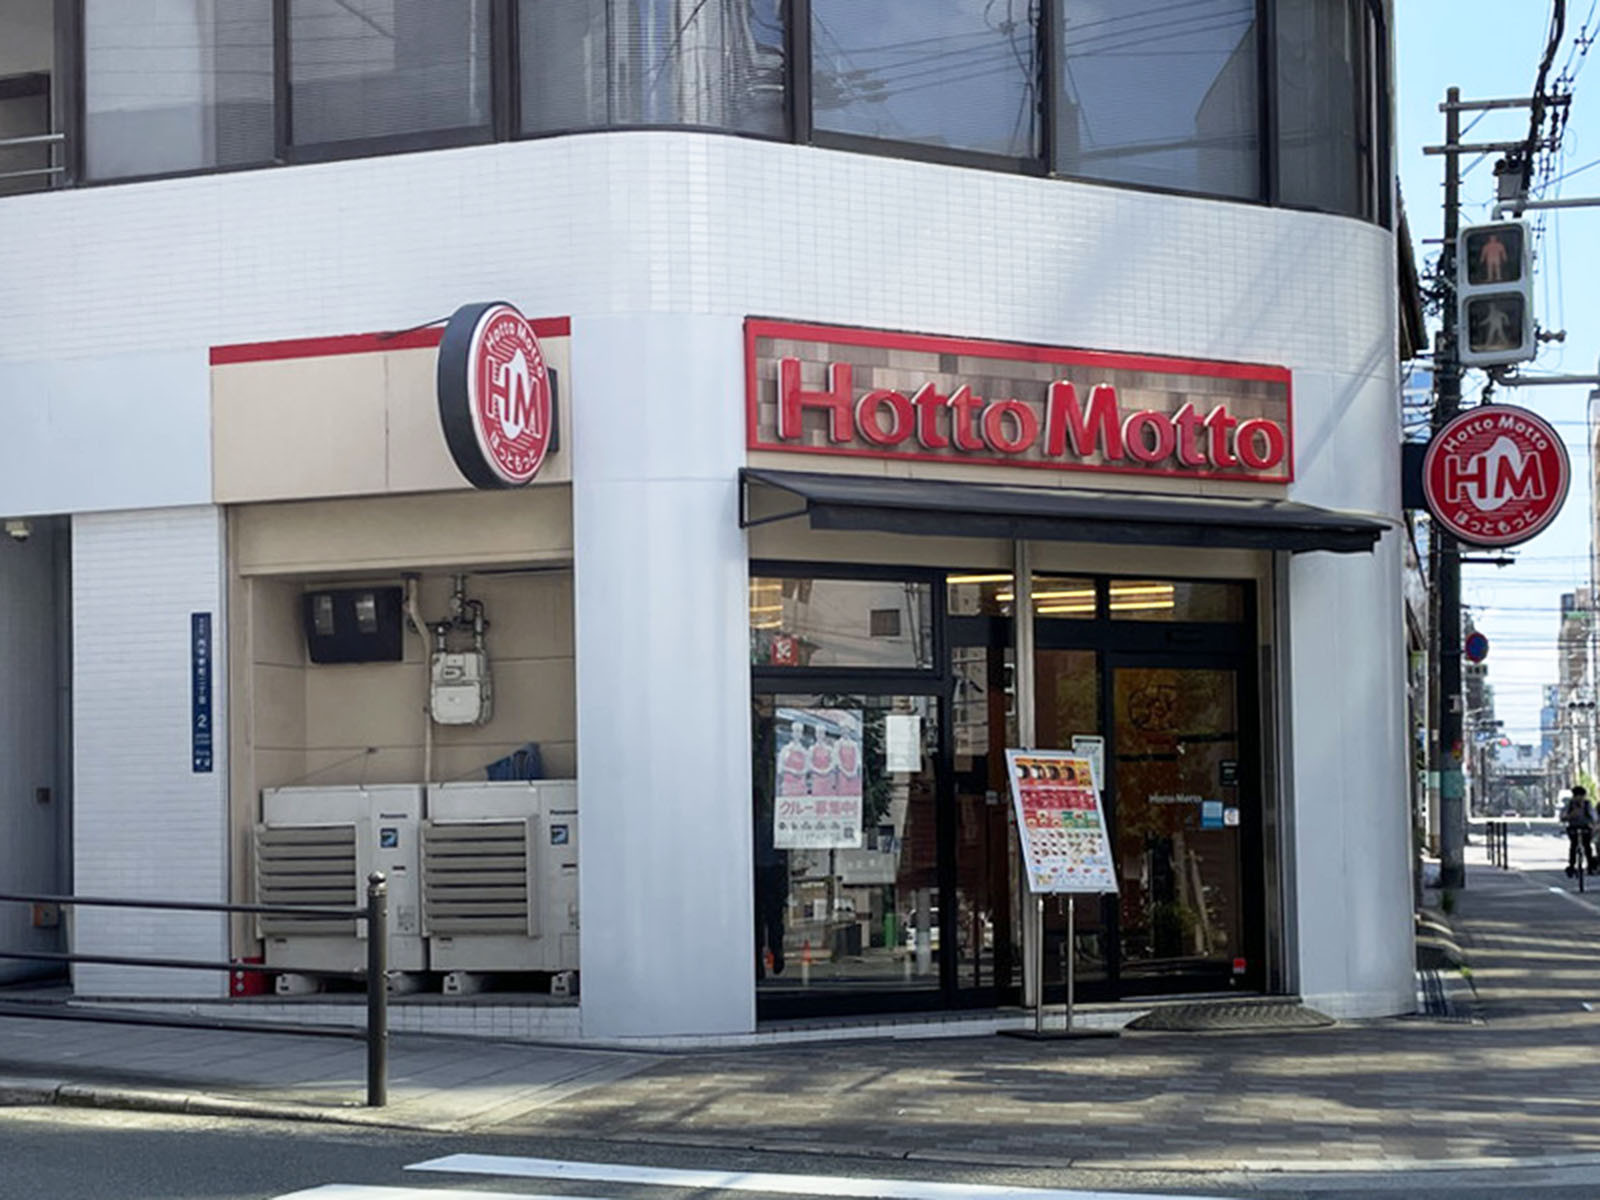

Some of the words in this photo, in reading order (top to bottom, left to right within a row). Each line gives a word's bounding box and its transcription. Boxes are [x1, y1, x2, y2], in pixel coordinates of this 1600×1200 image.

[486, 321, 515, 350] Hotto
[516, 322, 544, 378] Motto
[777, 357, 1038, 455] Hotto
[1044, 379, 1285, 469] Motto
[1442, 418, 1493, 454] Hotto
[1498, 415, 1548, 450] Motto
[1453, 509, 1538, 535] ほっともっと
[197, 713, 207, 729] 2
